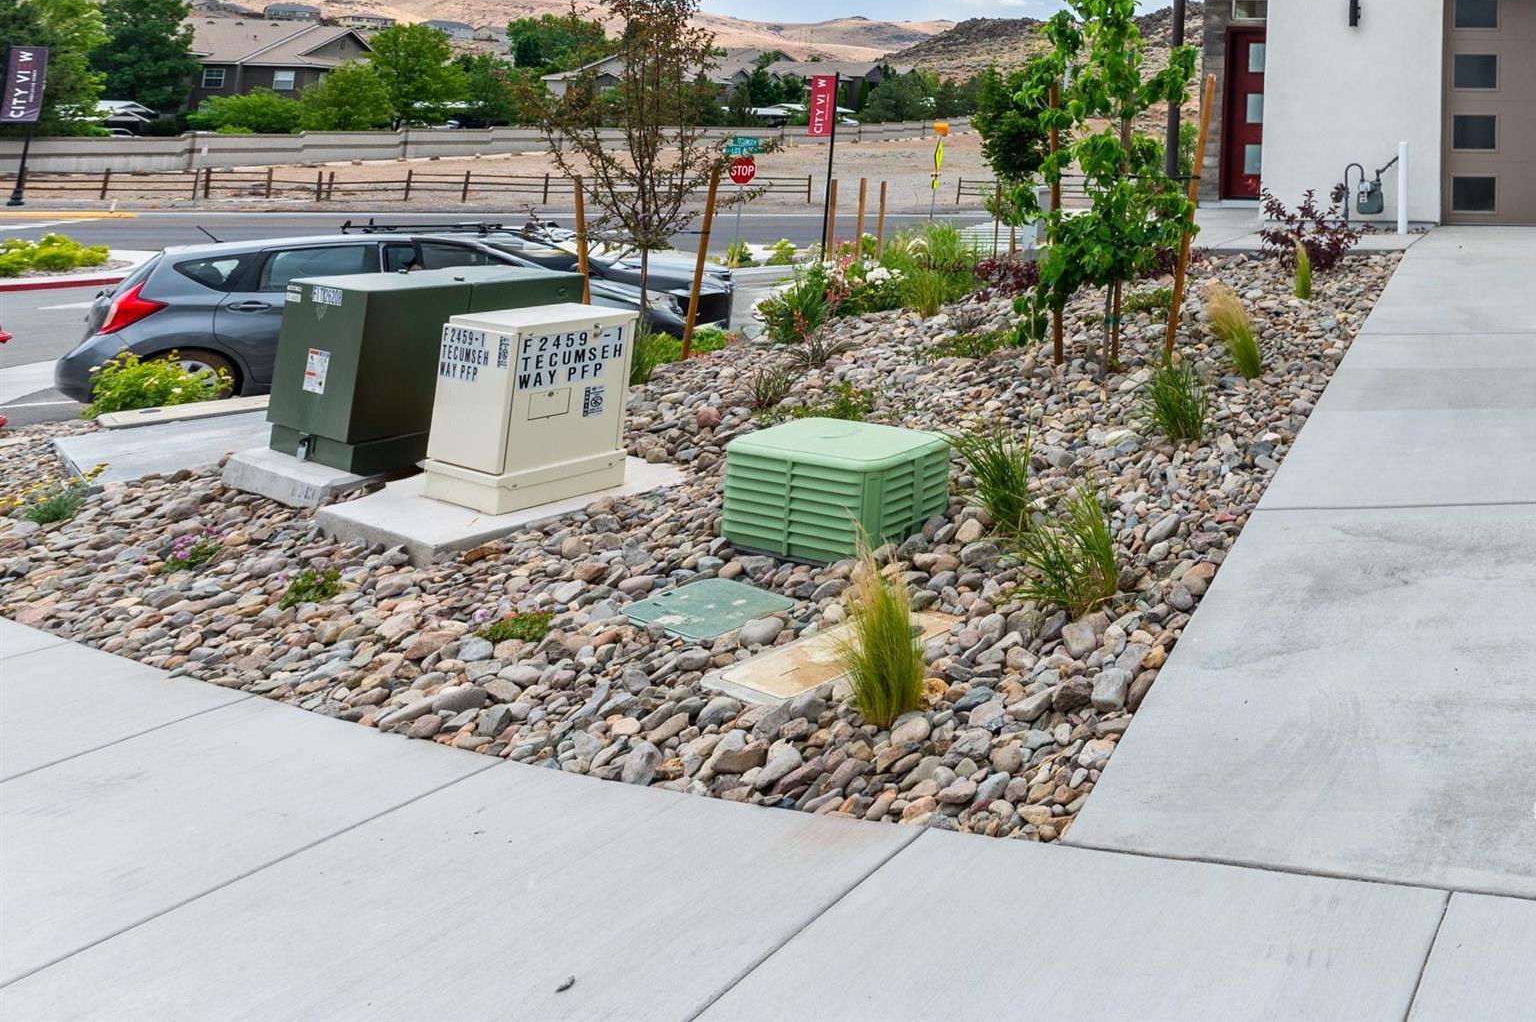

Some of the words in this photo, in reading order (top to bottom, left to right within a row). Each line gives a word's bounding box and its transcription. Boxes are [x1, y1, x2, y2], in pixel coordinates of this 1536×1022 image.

[9, 87, 29, 118] CITY
[816, 78, 827, 105] VIW
[813, 109, 825, 134] CITY
[730, 165, 755, 176] STOP
[442, 344, 489, 367] TECUMSEH
[521, 343, 623, 371] TECUMSEH
[439, 361, 457, 378] WAY
[460, 364, 478, 382] PFP
[518, 369, 557, 389] WAY
[567, 362, 603, 382] PFP
